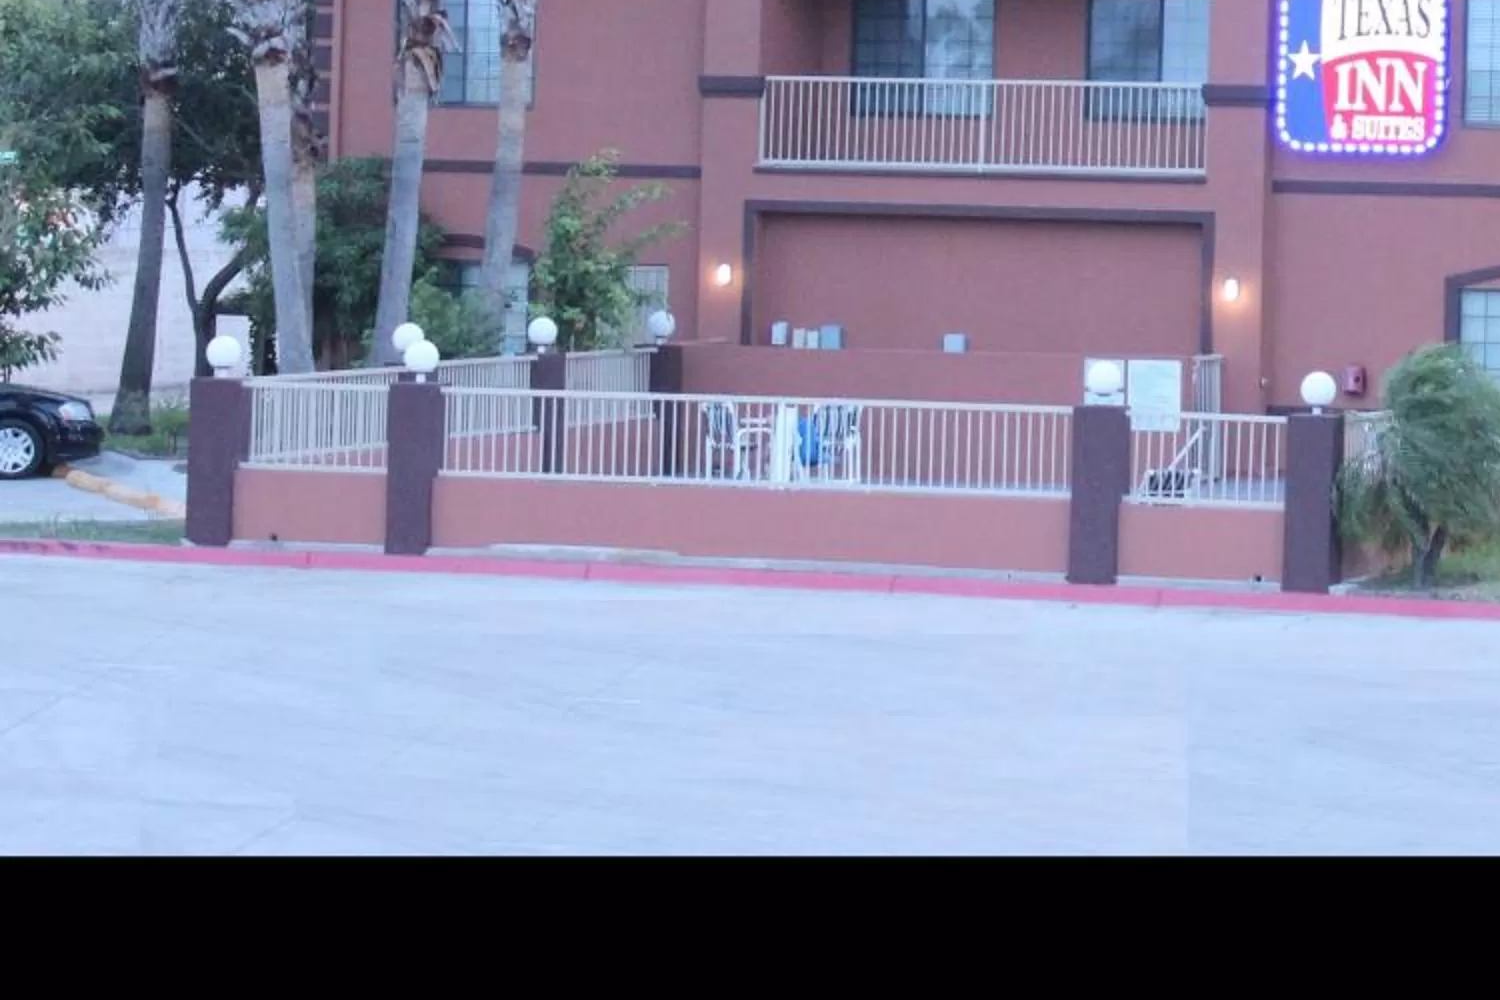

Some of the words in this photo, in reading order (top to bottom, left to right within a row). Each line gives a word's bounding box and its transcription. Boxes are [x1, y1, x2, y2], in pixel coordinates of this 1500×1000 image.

[1334, 56, 1427, 114] INN
[1331, 113, 1348, 139] &
[1352, 115, 1425, 140] SUITES
